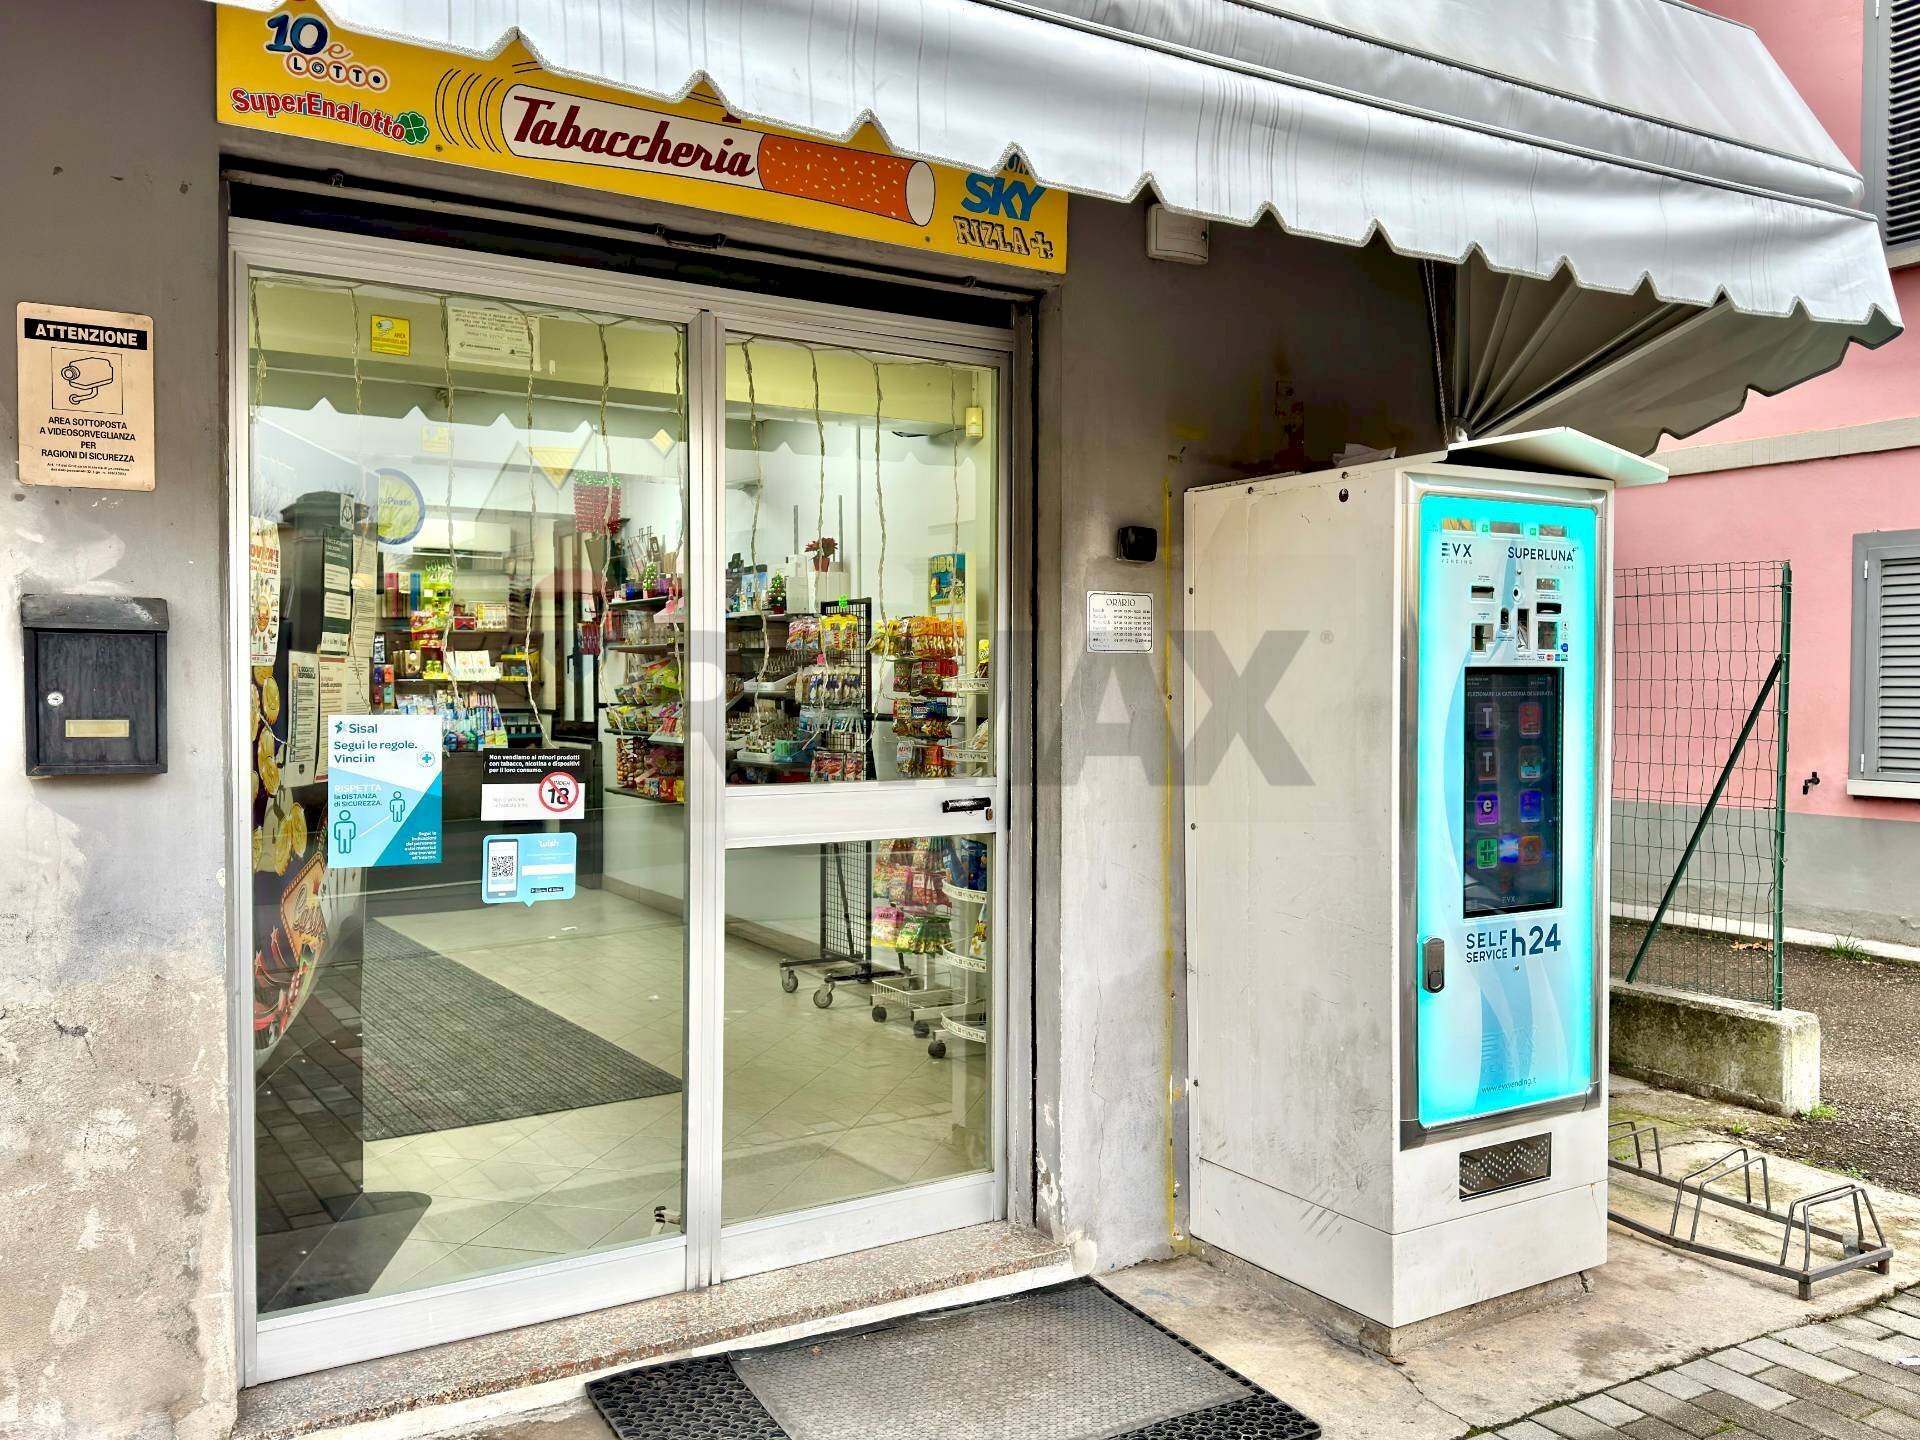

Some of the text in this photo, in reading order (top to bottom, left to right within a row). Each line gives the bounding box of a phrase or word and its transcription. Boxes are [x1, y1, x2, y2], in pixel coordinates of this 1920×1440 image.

[287, 53, 388, 91] LOTTO
[231, 88, 406, 143] SuperEnalotto
[514, 95, 754, 180] Tabaccheria
[961, 173, 1047, 221] SKY
[35, 323, 138, 346] ATTENZIONE
[48, 416, 127, 430] AREA SOTTOPOSTA
[40, 427, 136, 441] A VIDEOSORVEGLIANZA
[81, 441, 96, 449] PER
[41, 449, 135, 462] RAGIONI DI SICUREZZA
[1441, 543, 1472, 558] EVX
[1106, 598, 1136, 607] ORARIO
[349, 723, 378, 734] Sisal
[334, 740, 418, 752] Segui le regole.
[334, 754, 375, 763] Vinci in
[556, 754, 580, 762] prodotti
[334, 784, 382, 793] RISPETTA
[548, 788, 569, 804] 18
[1466, 929, 1508, 950] SELF
[1511, 923, 1561, 957] h24
[1466, 948, 1508, 963] SERVICE
